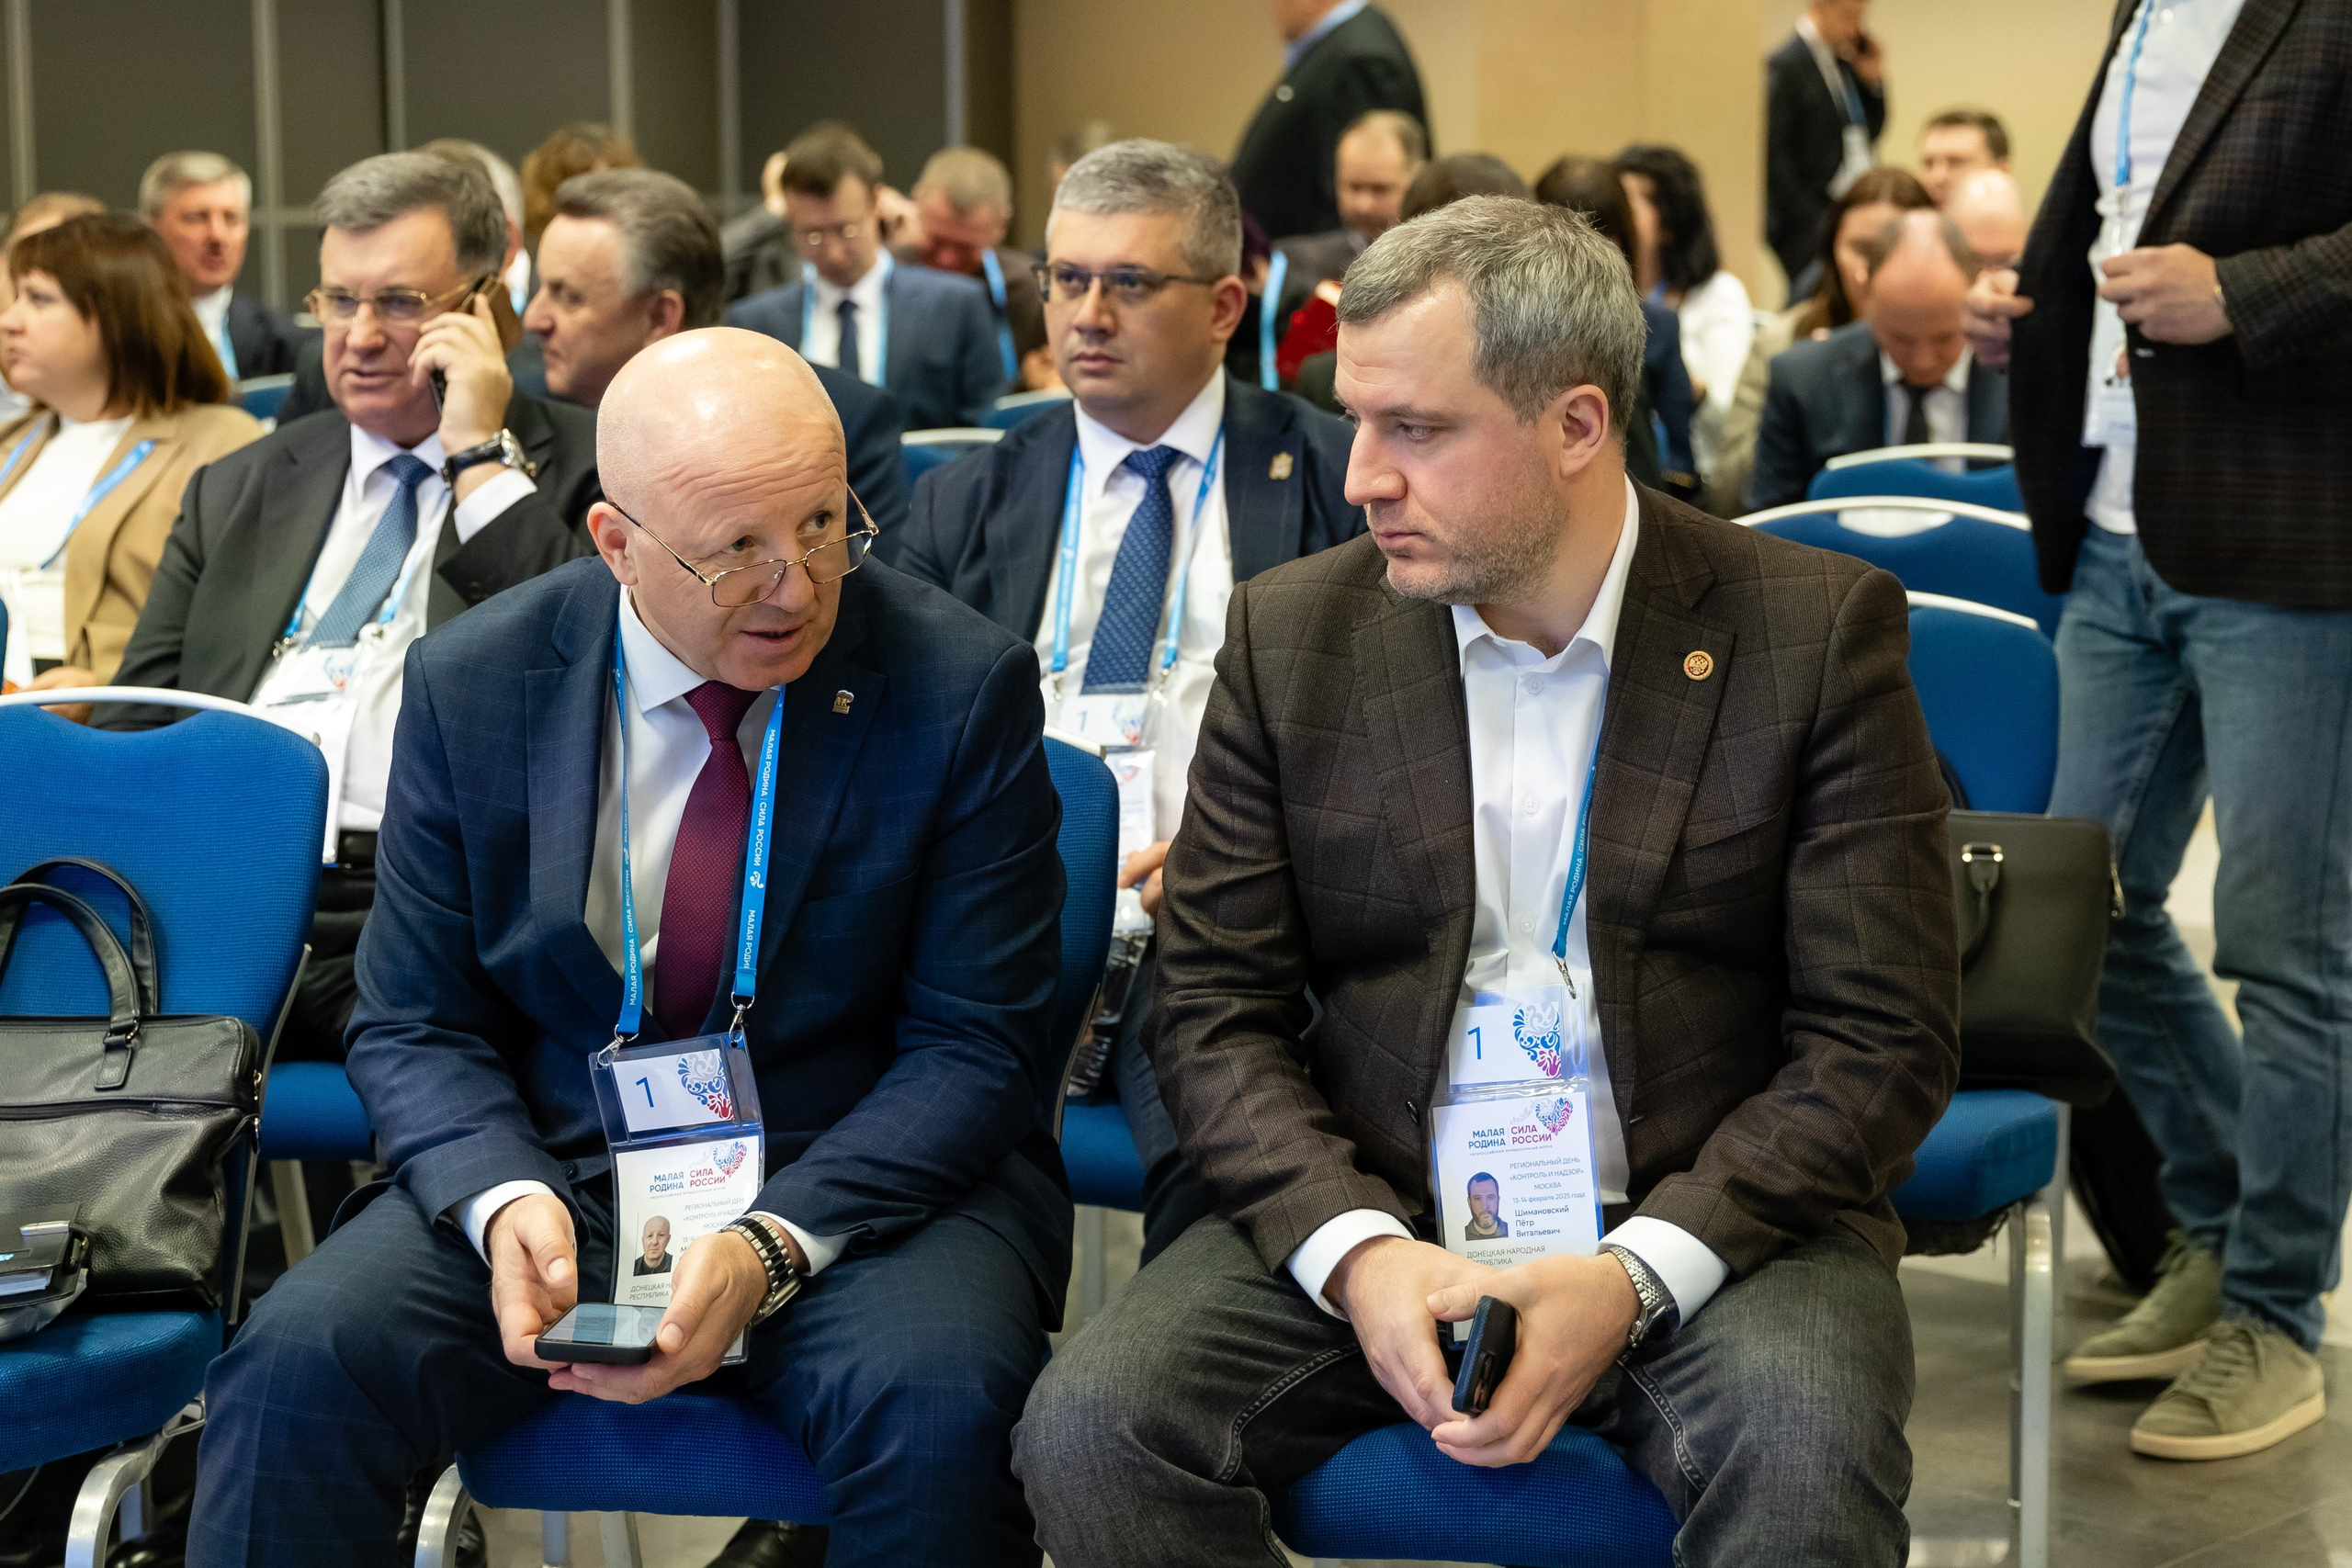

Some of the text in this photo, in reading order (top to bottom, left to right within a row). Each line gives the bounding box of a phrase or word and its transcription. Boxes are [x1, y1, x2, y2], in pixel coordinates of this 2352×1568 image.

[753, 728, 775, 866] МАЛАЯ РОДИНА СИЛА РОССИИ
[1562, 894, 1574, 926] МАЛАЯ
[1570, 857, 1583, 894] РОДИНА
[746, 909, 755, 941] МАЛАЯ
[628, 938, 637, 974] РОДИНА
[629, 976, 638, 1006] МАЛАЯ
[1467, 1026, 1482, 1060] 1
[635, 1076, 654, 1108] 1
[1473, 1127, 1505, 1139] МАЛАЯ
[1510, 1123, 1538, 1135] СИЛА
[1468, 1138, 1506, 1149] РОДИНА
[1511, 1134, 1552, 1145] РОССИИ
[1510, 1156, 1580, 1169] РЕГИОНАЛЬНЫЙ ДЕНЬ
[654, 1171, 684, 1183] МАЛАЯ
[690, 1168, 714, 1179] СИЛА
[1510, 1171, 1548, 1181] «КОНТРОЛЬ
[1555, 1168, 1584, 1177] НАДЗОР»
[650, 1181, 684, 1193] РОДИНА
[690, 1176, 726, 1188] РОССИИ
[1533, 1181, 1562, 1190] МОСКВА
[684, 1197, 731, 1211] РЕГИОНАЛЬНЫЙ
[1512, 1196, 1528, 1204] 13-14
[1528, 1194, 1555, 1204] февраля
[1515, 1205, 1569, 1217] Шимановский
[703, 1221, 728, 1229] МОСКВА
[1515, 1219, 1534, 1228] Пётр
[1516, 1228, 1561, 1237] Витальевич
[1466, 1246, 1545, 1258] ДОНЕЦКАЯ НАРОДНАЯ
[1472, 1258, 1513, 1266] СПУБЛИКА
[630, 1282, 665, 1293] ДОНЕЦКАЯ
[629, 1291, 669, 1301] РЕСПУБЛИКА
